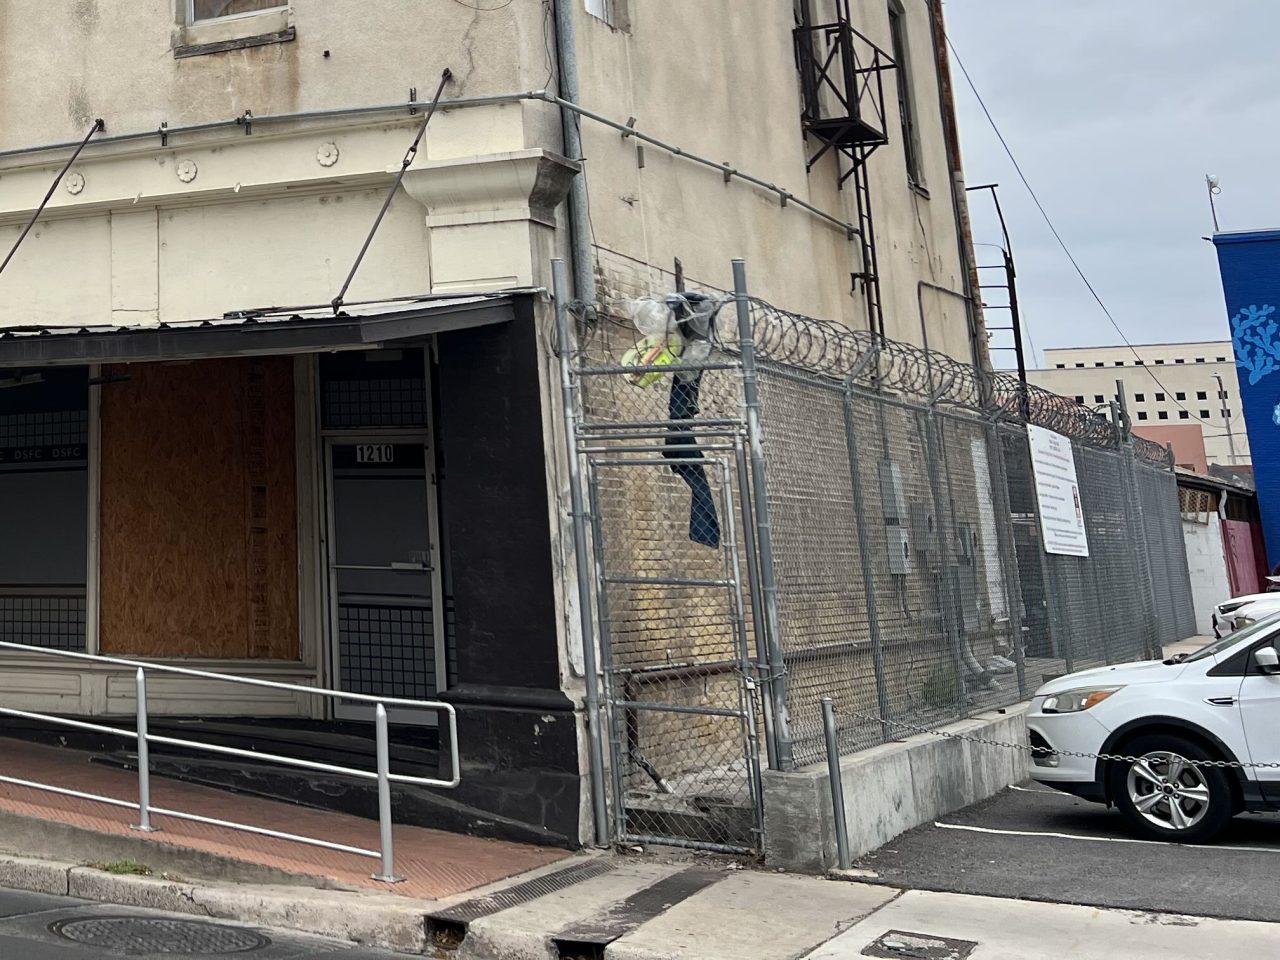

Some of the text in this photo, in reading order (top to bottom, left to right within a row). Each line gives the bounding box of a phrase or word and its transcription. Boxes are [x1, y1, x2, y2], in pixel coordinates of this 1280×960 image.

[14, 449, 42, 460] DSFC
[52, 447, 81, 458] DSFC
[358, 445, 393, 461] 1210
